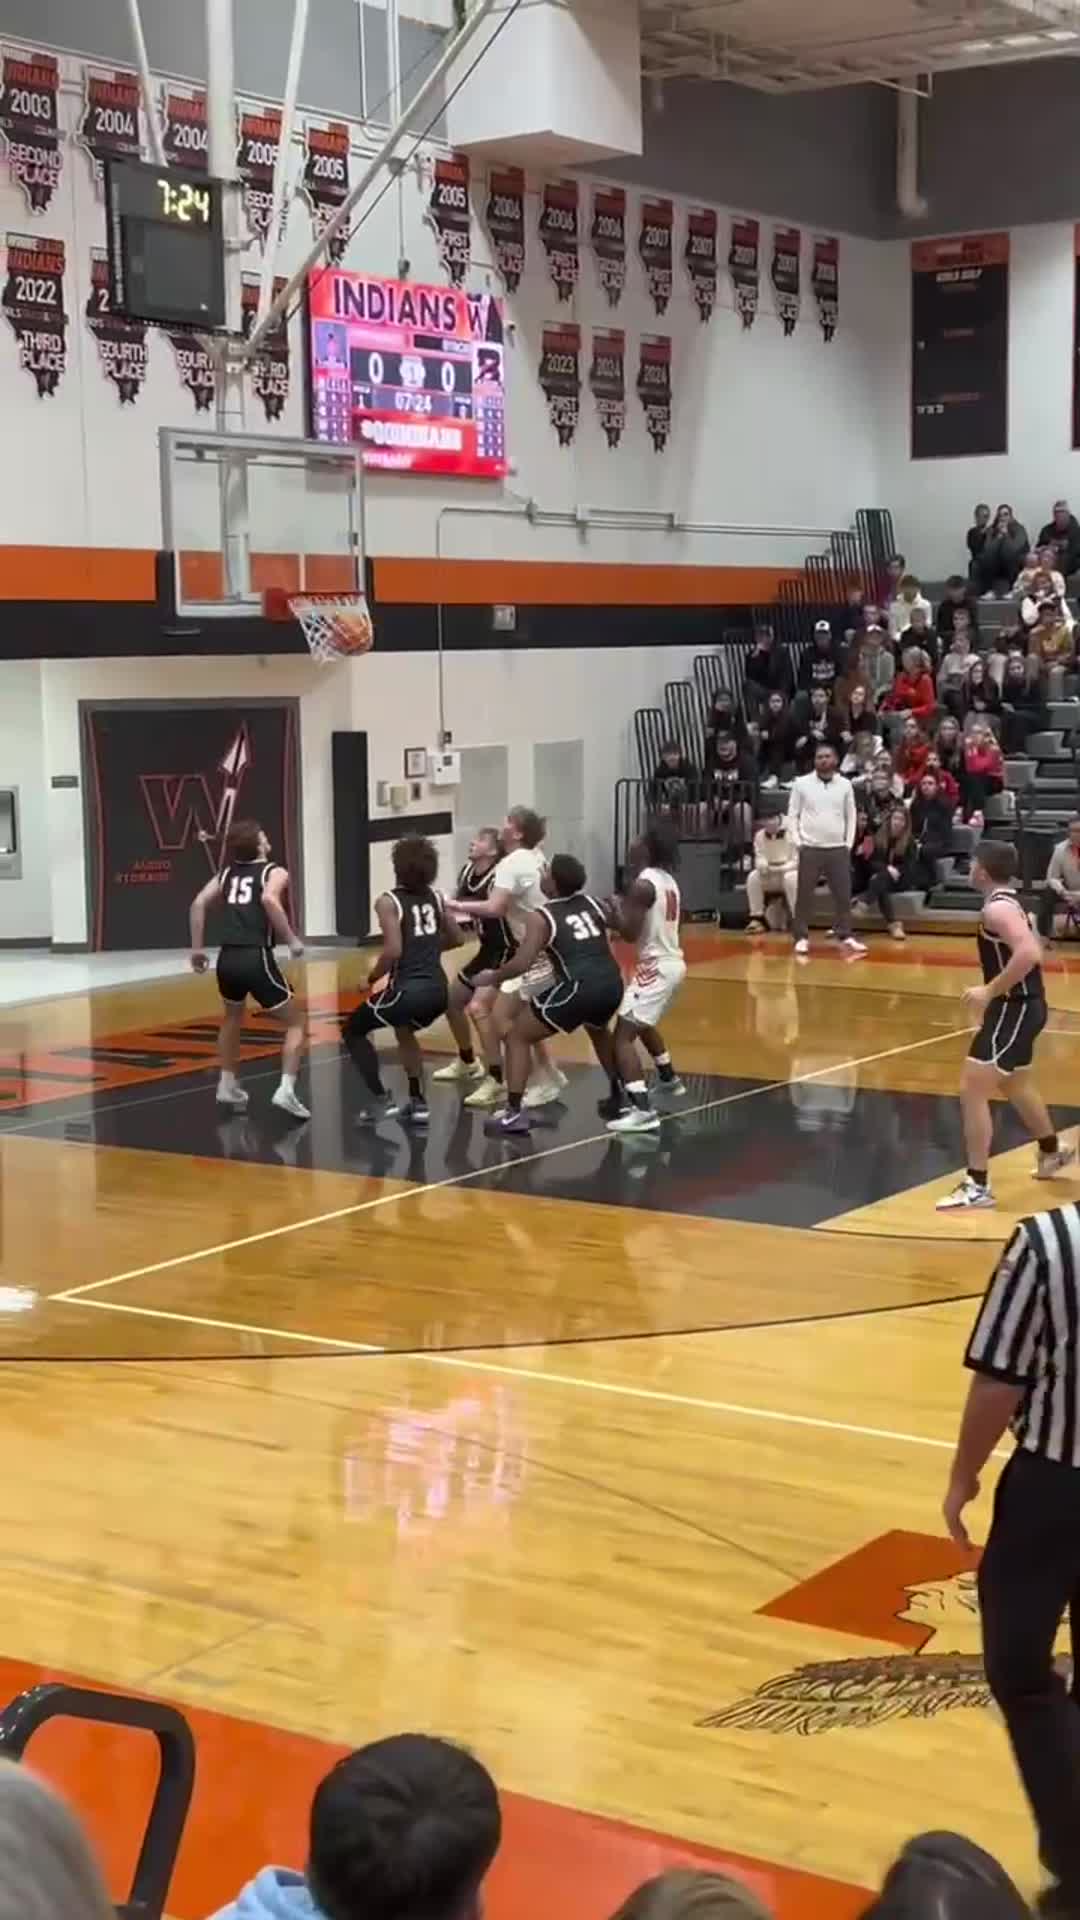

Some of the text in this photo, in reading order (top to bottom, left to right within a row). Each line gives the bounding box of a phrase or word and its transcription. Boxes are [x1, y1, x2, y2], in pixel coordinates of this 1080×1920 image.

[10, 89, 51, 119] 2003
[95, 108, 135, 136] 2004
[10, 142, 62, 168] SECOND
[313, 155, 345, 180] 2005
[15, 163, 60, 187] PLACE
[157, 179, 210, 223] 7:24
[438, 183, 466, 207] 2005
[441, 230, 468, 247] FIRST
[16, 276, 57, 305] 2022
[334, 278, 457, 331] INDIANS
[22, 331, 62, 352] THIRD
[101, 340, 148, 362] FOURTH
[22, 350, 65, 373] PLACE
[105, 359, 146, 382] PLACE
[368, 352, 384, 385] 0
[547, 353, 575, 374] 2023
[252, 377, 289, 396] PLACE
[441, 361, 456, 392] 0
[227, 876, 254, 904] 15
[411, 904, 438, 937] 13
[565, 914, 601, 941] 31
